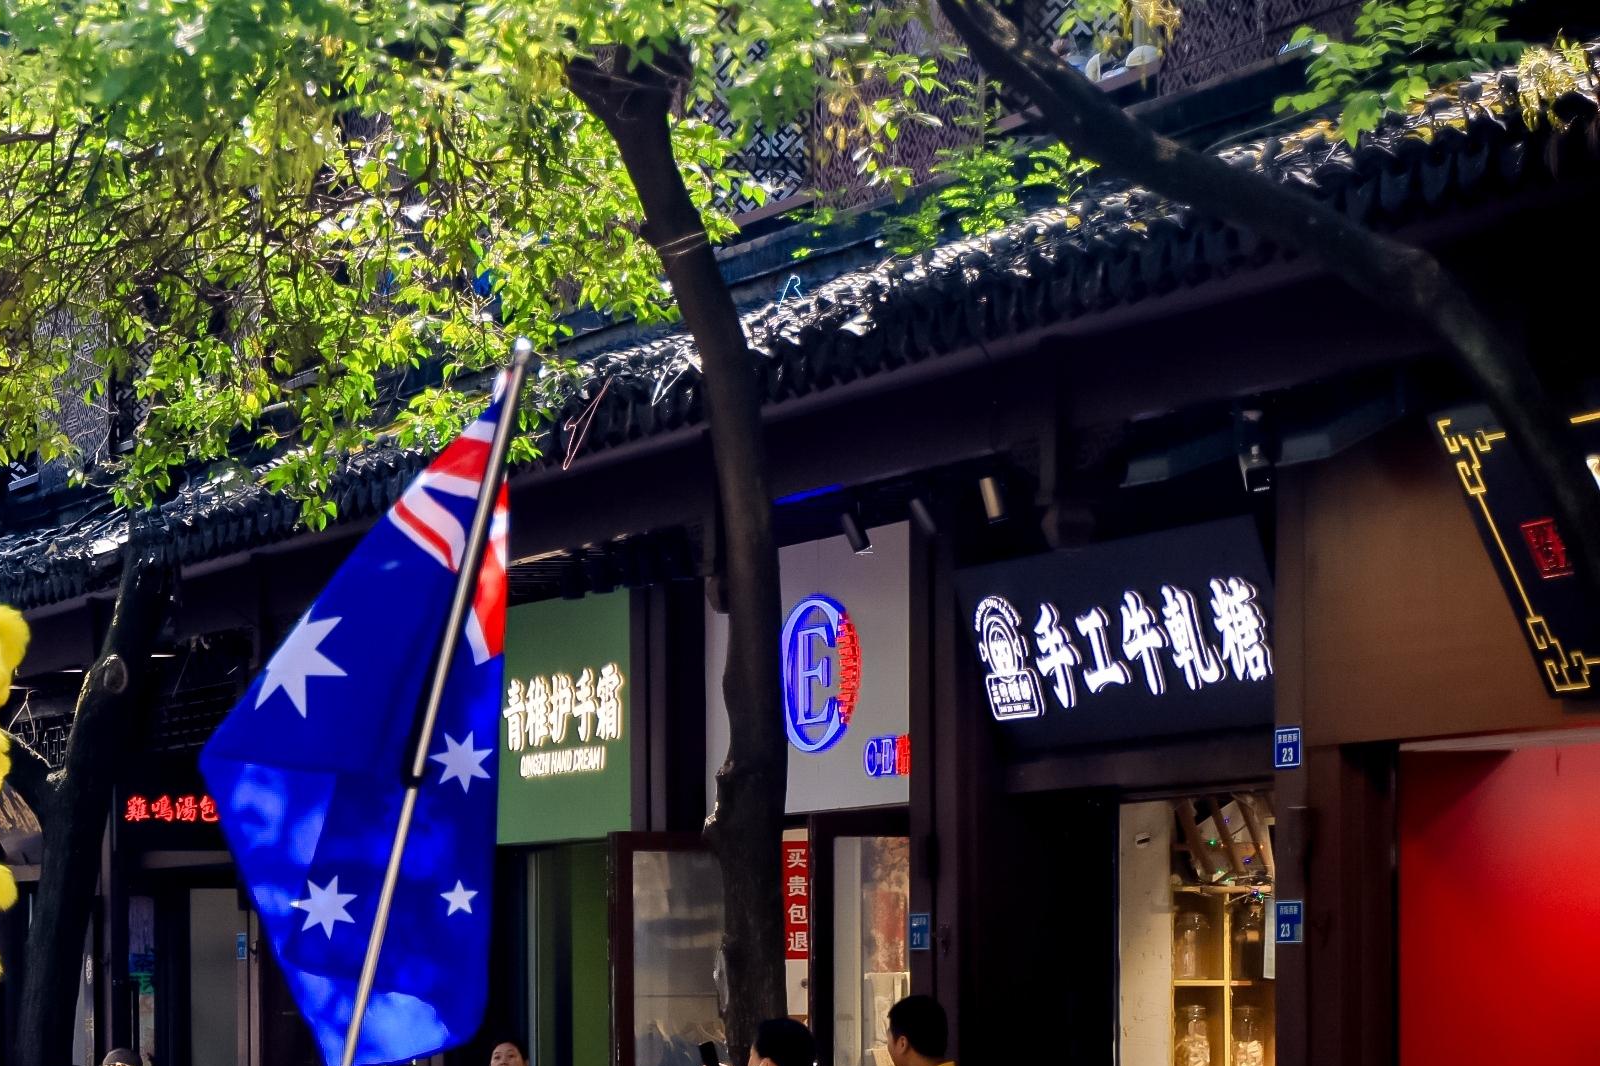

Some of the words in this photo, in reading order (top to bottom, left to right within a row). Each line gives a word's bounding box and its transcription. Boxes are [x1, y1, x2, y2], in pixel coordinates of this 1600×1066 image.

[1282, 747, 1294, 763] 23
[787, 848, 808, 952] 买贵包退
[1280, 923, 1291, 938] 23
